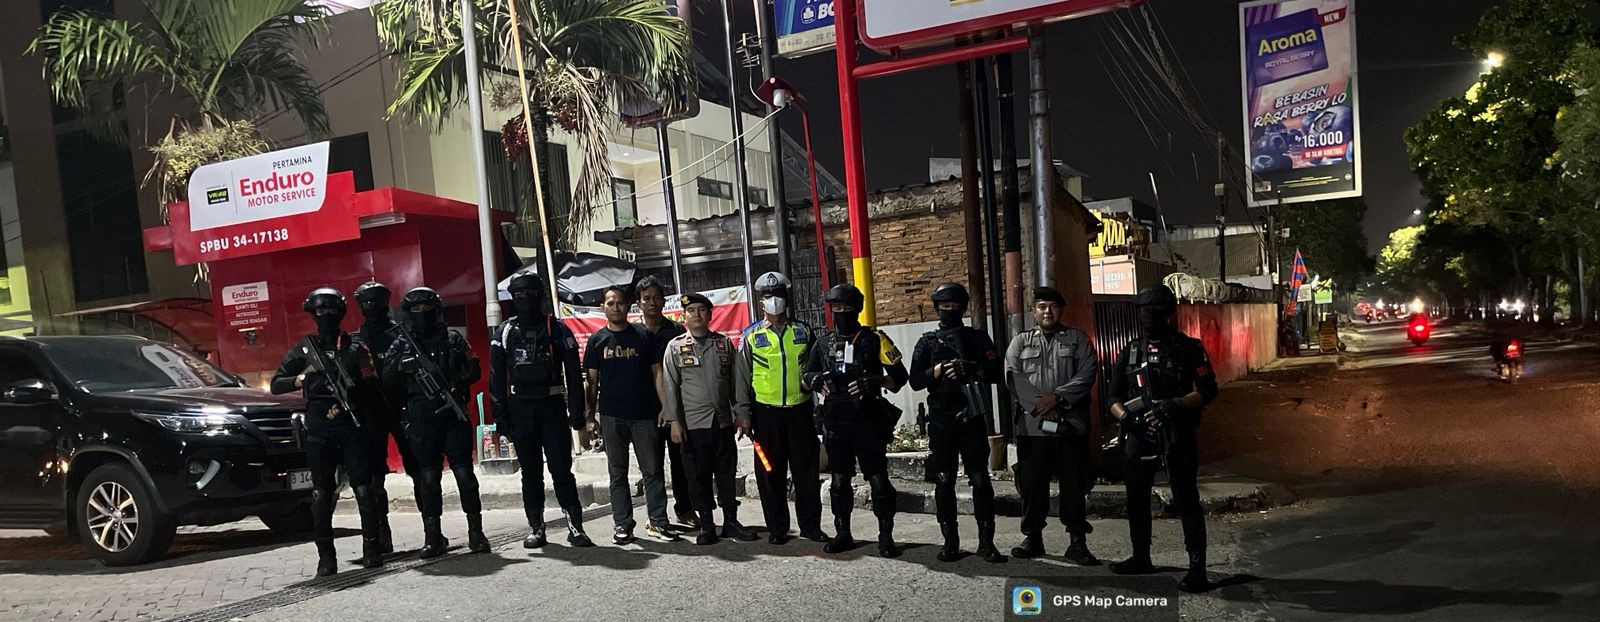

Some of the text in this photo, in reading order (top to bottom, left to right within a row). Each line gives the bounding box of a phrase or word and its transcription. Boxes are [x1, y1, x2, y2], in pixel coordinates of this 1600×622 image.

[1323, 12, 1340, 23] NEW
[1258, 28, 1317, 56] Aroma
[1275, 84, 1329, 109] BEBASIN
[1254, 93, 1347, 128] RASA BERRY LO
[1302, 130, 1343, 148] 16.000
[272, 155, 313, 170] PERTAMINA
[239, 171, 315, 197] Enduro
[247, 187, 316, 208] MOTOR SERVICE
[200, 228, 289, 253] SPBU 34-17138
[231, 289, 259, 299] Enduro
[300, 472, 312, 483] 14
